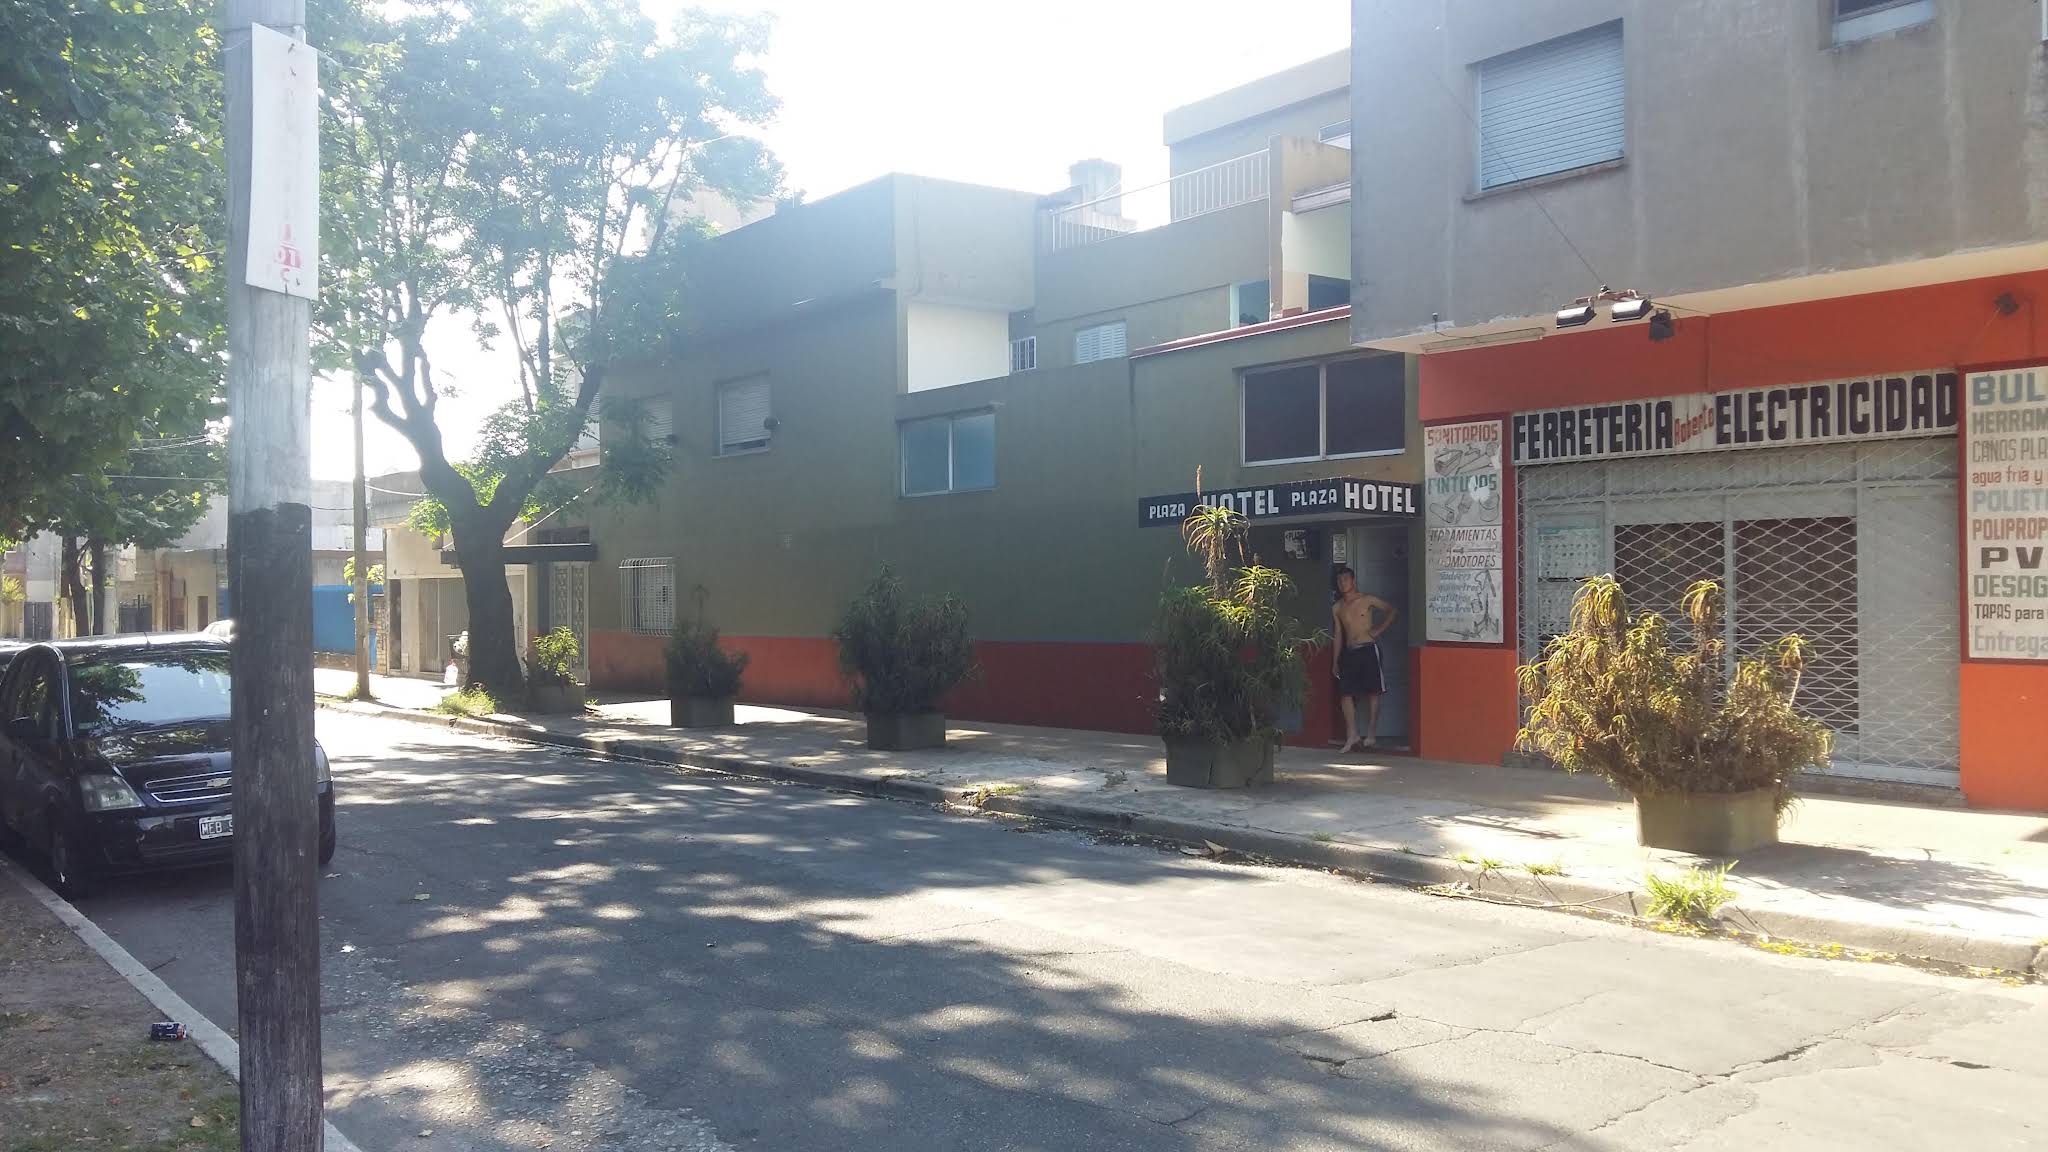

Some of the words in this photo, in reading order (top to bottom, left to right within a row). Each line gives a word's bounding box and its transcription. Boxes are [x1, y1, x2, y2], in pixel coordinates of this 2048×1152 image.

[1513, 400, 1673, 461] FERRETERIA
[1674, 402, 1715, 446] Roberto
[1716, 372, 1958, 445] ELECTRICIDAD
[1972, 471, 2002, 487] agua
[2034, 469, 2044, 486] y
[1150, 503, 1186, 520] PLAZA
[1202, 489, 1279, 517] HOTEL
[1291, 488, 1337, 508] PLAZA
[1344, 482, 1416, 514] HOTEL
[1974, 603, 2011, 620] TAPAS
[2015, 607, 2045, 623] para
